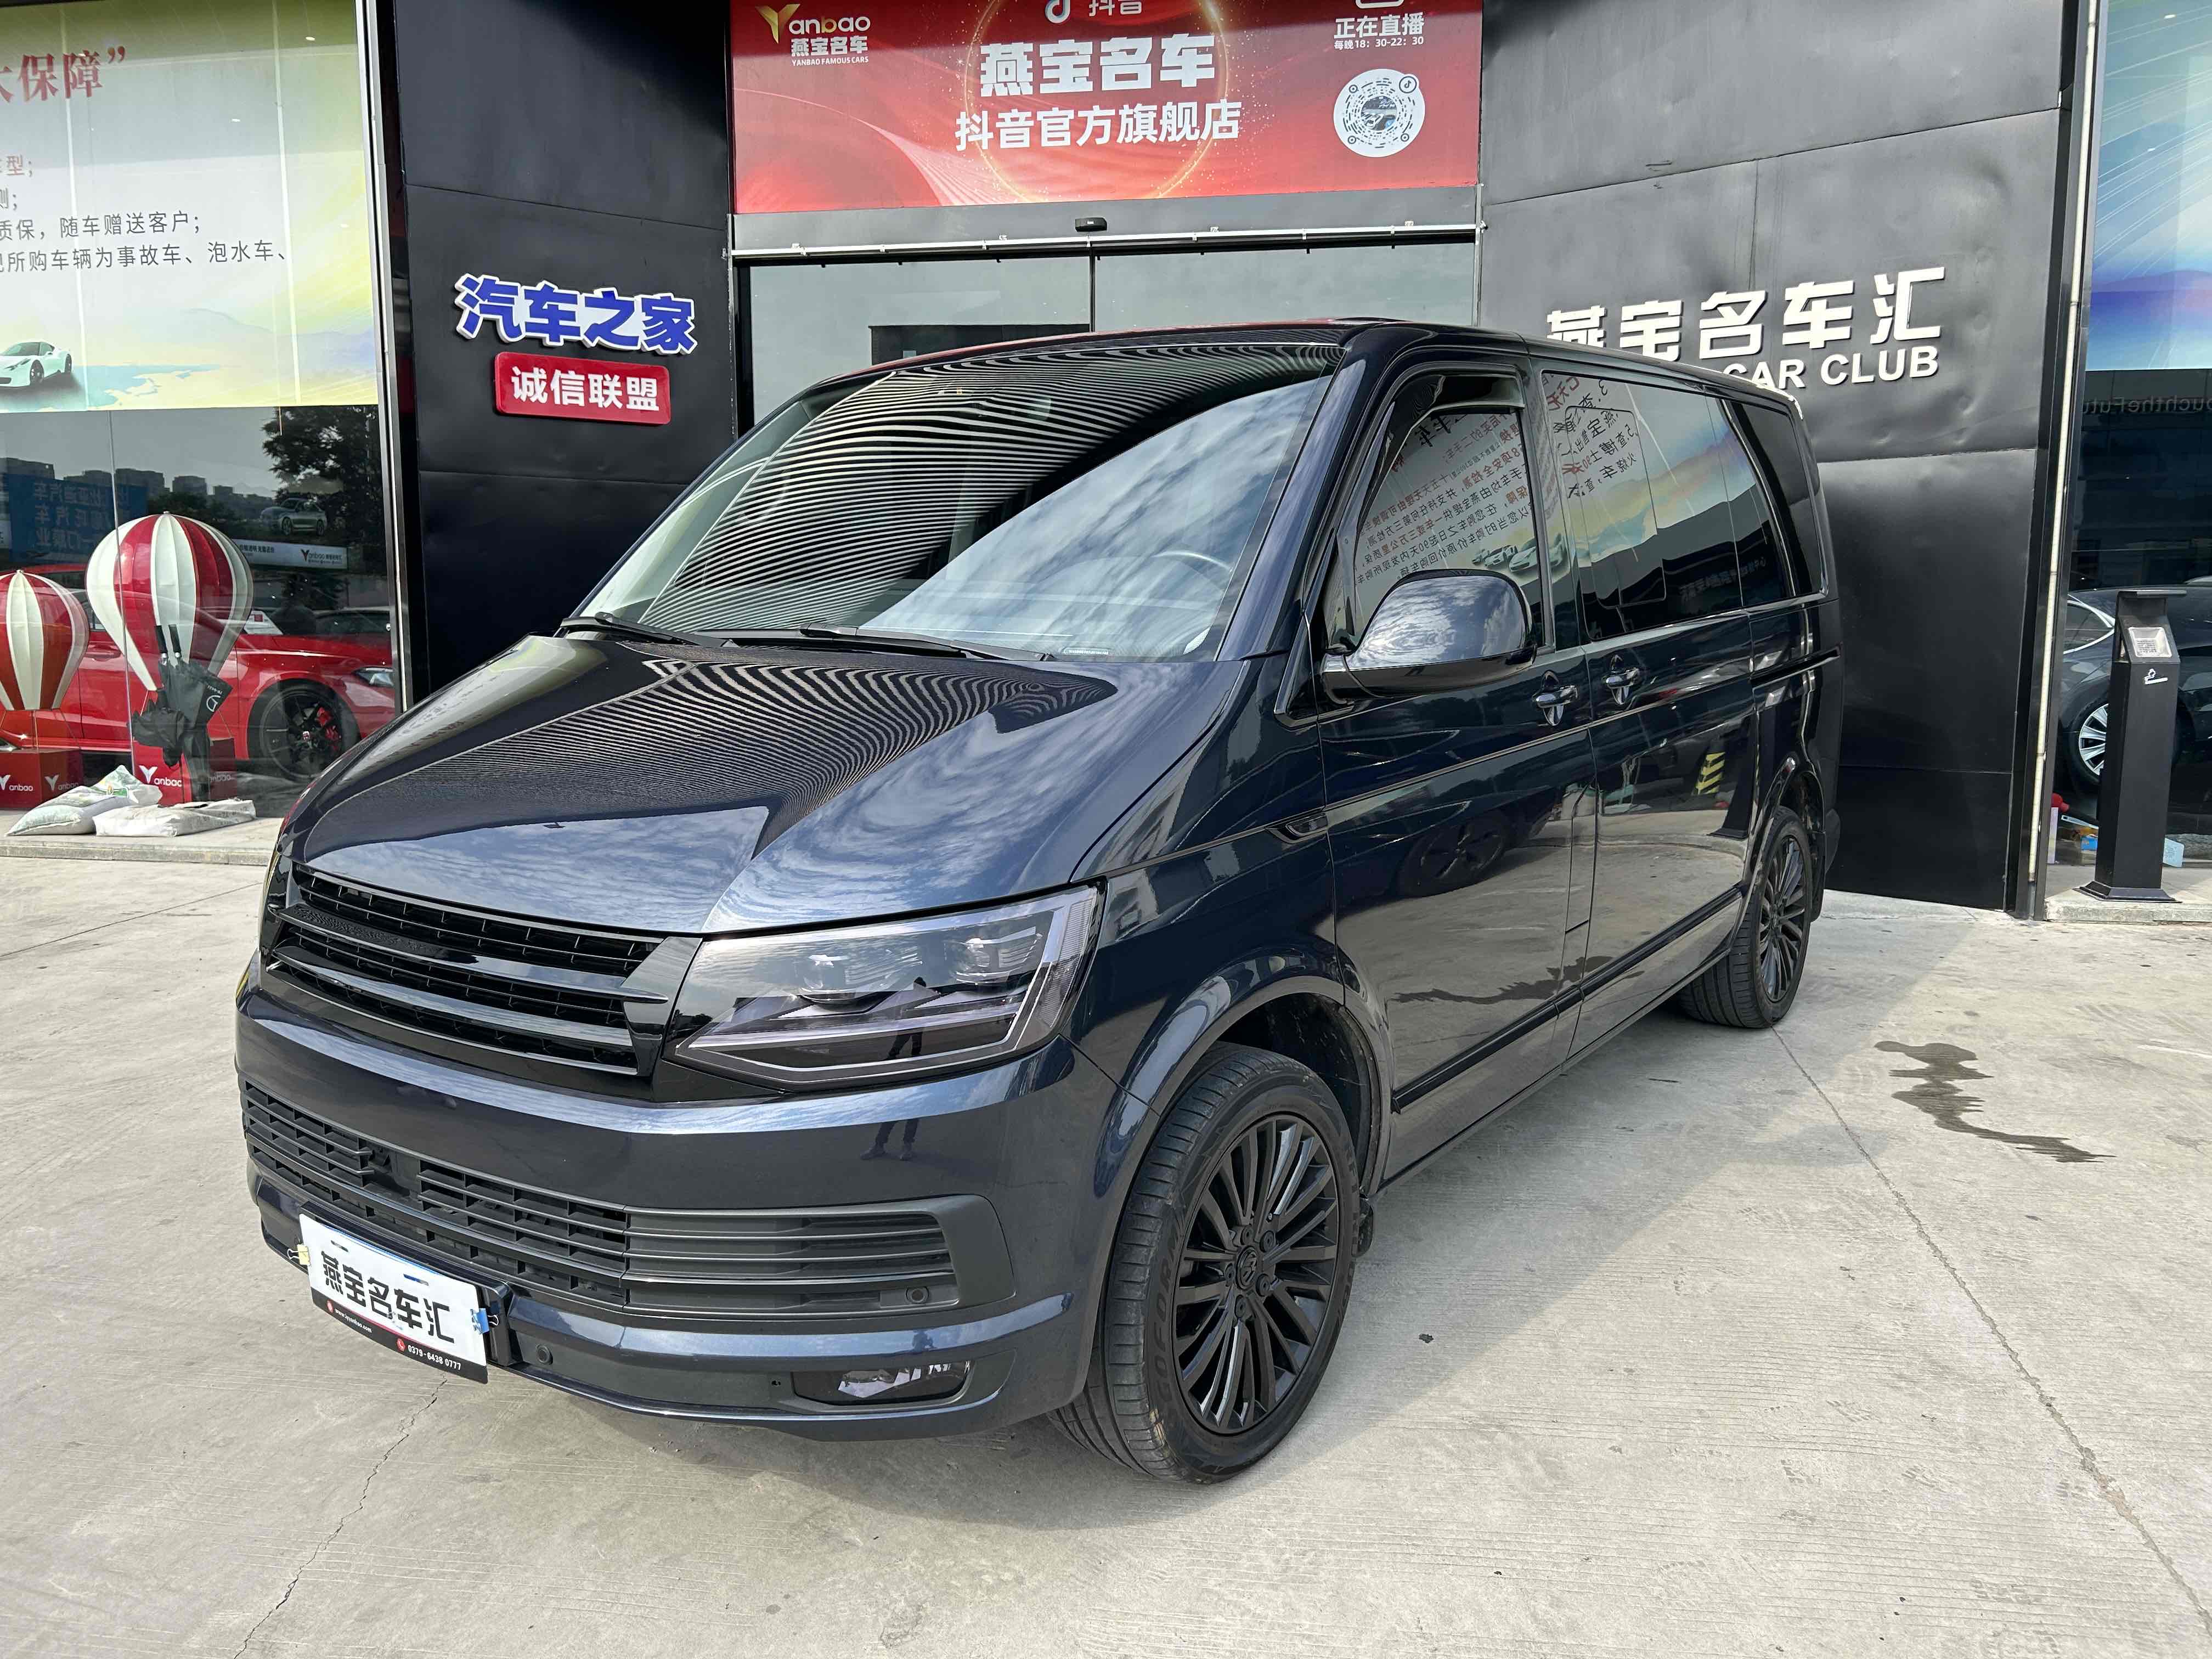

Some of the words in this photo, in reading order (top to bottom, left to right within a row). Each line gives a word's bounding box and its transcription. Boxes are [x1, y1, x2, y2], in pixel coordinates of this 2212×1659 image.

[791, 36, 868, 57] 燕宝名车
[1334, 12, 1424, 39] 正在直播
[980, 33, 1215, 97] 燕宝名车
[955, 99, 1242, 151] 抖音官方旗舰店
[455, 273, 698, 354] 汽车之家
[1820, 346, 1938, 385] CLUB
[511, 366, 660, 411] 诚信联盟
[321, 1250, 456, 1344] 燕宝名车汇
[408, 1345, 443, 1365] 0379-6438
[444, 1358, 461, 1371] 0777
